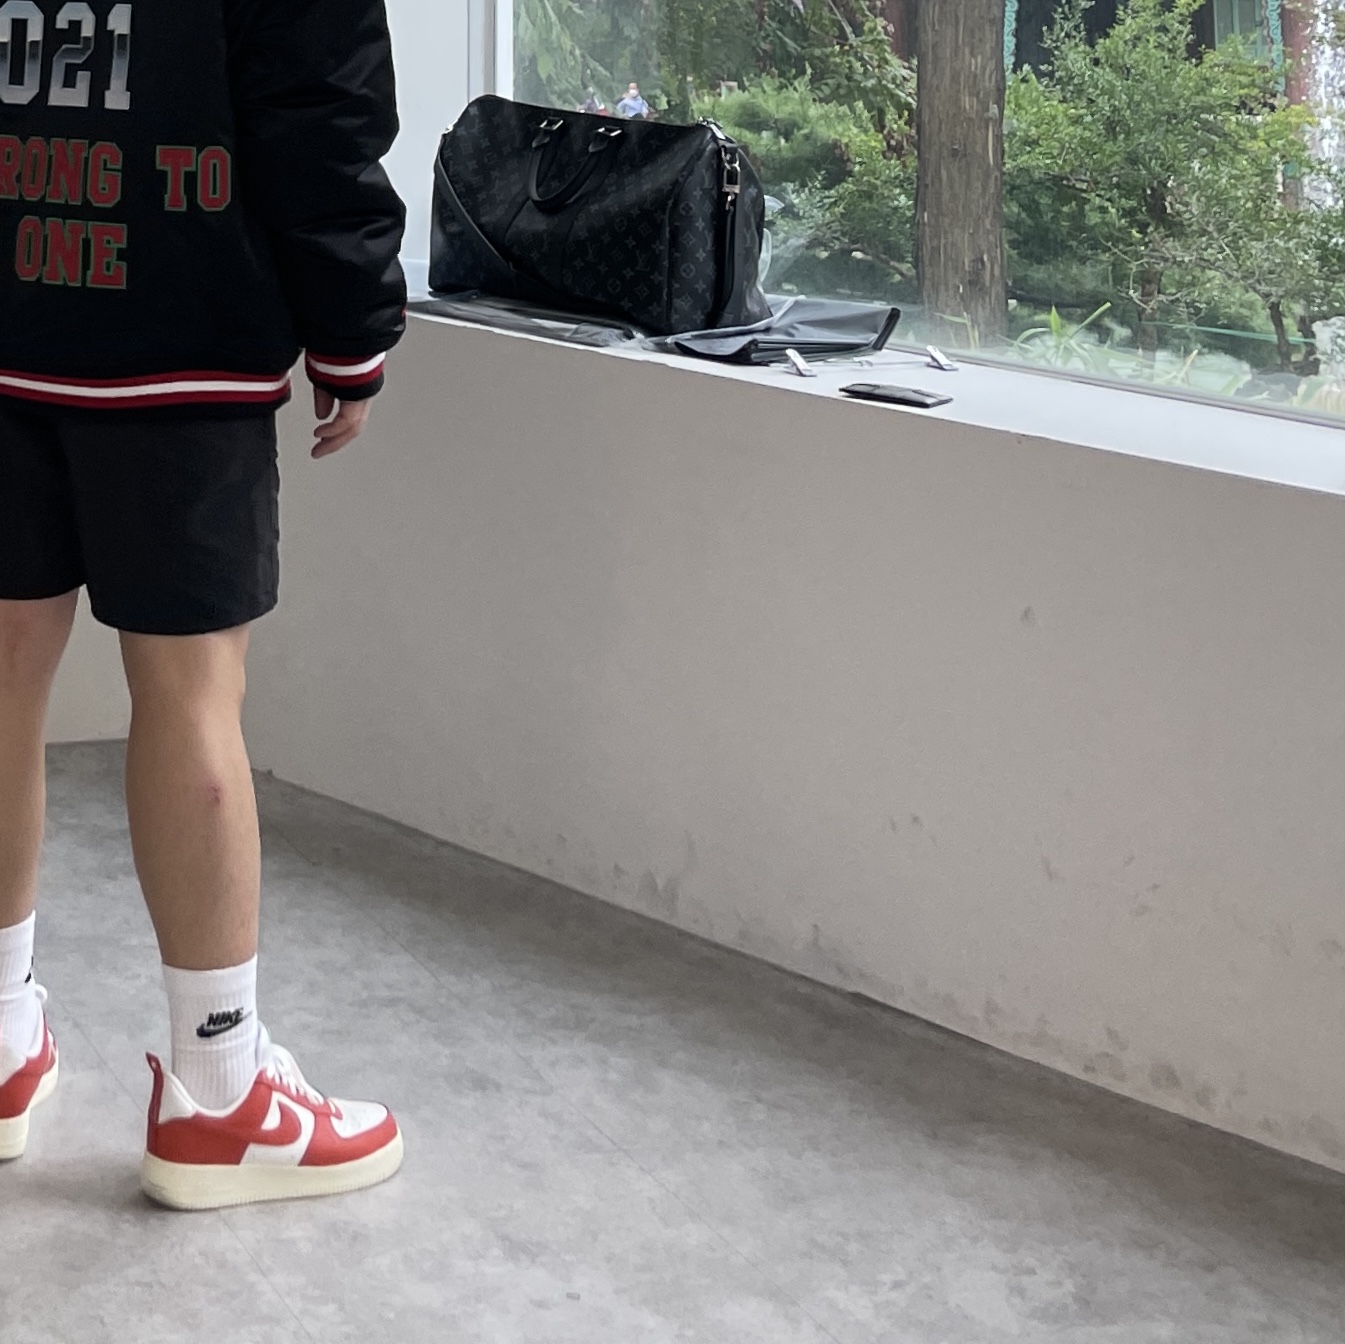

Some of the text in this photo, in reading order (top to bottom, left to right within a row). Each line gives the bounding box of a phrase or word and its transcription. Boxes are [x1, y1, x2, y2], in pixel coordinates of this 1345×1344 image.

[156, 145, 232, 212] TO
[15, 216, 127, 290] ONE
[206, 1007, 244, 1027] NIKE
